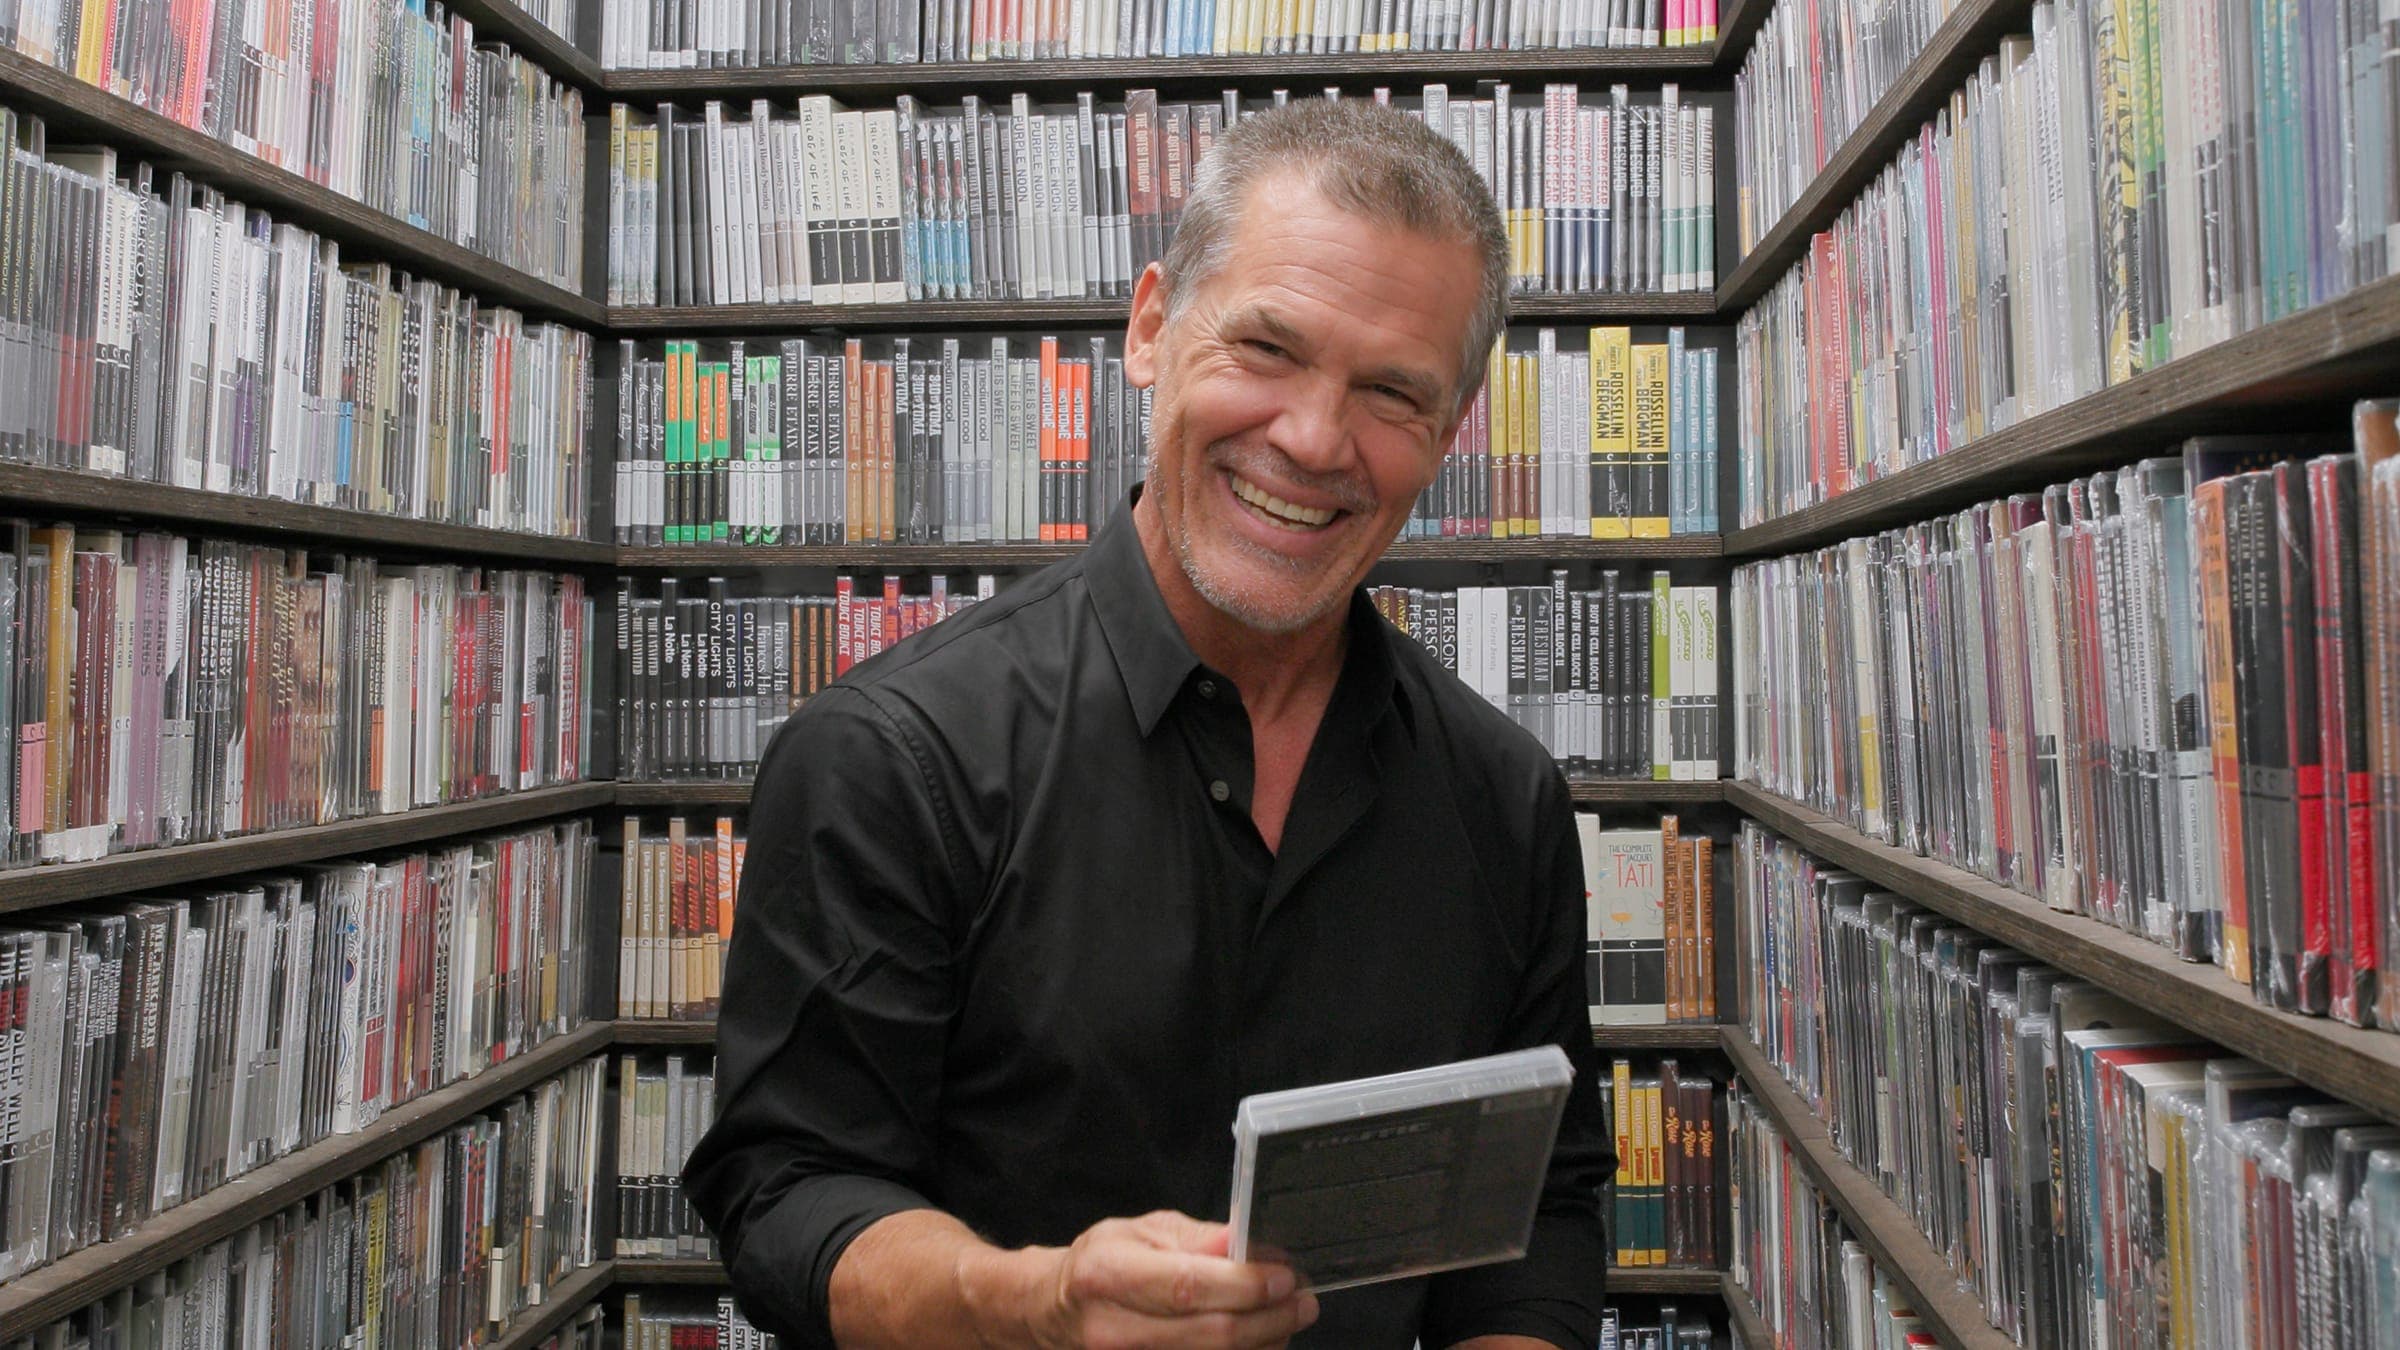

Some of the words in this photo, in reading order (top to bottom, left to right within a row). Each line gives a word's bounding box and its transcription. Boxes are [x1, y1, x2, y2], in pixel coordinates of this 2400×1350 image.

[1136, 112, 1148, 128] THE
[1168, 118, 1179, 134] THE
[1562, 93, 1576, 150] MINISTRY
[1664, 102, 1676, 160] BADLANDS
[1014, 116, 1025, 164] PURPLE
[1032, 122, 1042, 170] PURPLE
[1048, 126, 1058, 174] PURPLE
[1065, 125, 1076, 174] PURPLE
[1136, 131, 1148, 155] QATSI
[1648, 128, 1659, 150] MAN
[1680, 120, 1694, 178] BADLANDS
[1699, 119, 1712, 176] BADLANDS
[810, 164, 818, 179] OF
[842, 170, 850, 182] OF
[874, 170, 882, 183] OF
[1136, 156, 1150, 192] TRILOGY
[1562, 154, 1576, 168] OF
[1598, 166, 1609, 177] OF
[1630, 154, 1642, 197] ESCAPED
[1648, 154, 1659, 198] ESCAPED
[1016, 170, 1028, 203] NOON
[1034, 176, 1045, 209] NOON
[1052, 180, 1062, 212] NOON
[1068, 179, 1079, 212] NOON
[1168, 162, 1181, 198] TRILOGY
[1562, 172, 1576, 204] FEAR
[1598, 180, 1609, 205] FEAR
[812, 184, 821, 212] LIFE
[844, 187, 852, 210] LIFE
[876, 187, 884, 209] LIFE
[945, 350, 955, 396] medium
[994, 349, 1004, 370] LIFE
[786, 352, 796, 402] PIERRE
[808, 359, 819, 409] PIERRE
[978, 368, 990, 414] medium
[994, 375, 1004, 385] IS
[1026, 373, 1036, 394] LIFE
[896, 381, 908, 414] YUMA
[945, 398, 956, 422] cool
[962, 372, 972, 418] medium
[994, 390, 1004, 426] SWEET
[1026, 399, 1036, 408] IS
[1596, 380, 1610, 439] BERGMAN
[1610, 372, 1624, 439] ROSSELLINI
[912, 402, 924, 436] YUMA
[928, 402, 942, 436] YUMA
[979, 417, 990, 441] cool
[1636, 388, 1650, 449] BERGMAN
[1650, 380, 1664, 448] ROSSELLINI
[962, 420, 973, 444] cool
[1026, 414, 1037, 450] SWEET
[2240, 504, 2250, 559] CITIZEN
[2254, 502, 2266, 558] CITIZEN
[618, 591, 628, 606] THE
[840, 590, 850, 620] TOUKI
[1554, 580, 1565, 600] RIOT
[2242, 572, 2253, 609] KANE
[2258, 572, 2268, 608] KANE
[664, 616, 675, 630] La
[711, 602, 720, 631] CITY
[1554, 602, 1565, 612] IN
[1554, 614, 1565, 632] CELL
[1590, 604, 1600, 624] RIOT
[648, 616, 658, 632] THE
[681, 634, 691, 646] La
[698, 634, 707, 646] La
[726, 614, 736, 644] CITY
[744, 612, 754, 642] CITY
[840, 624, 850, 656] BOUKI
[854, 608, 864, 640] TOUKI
[1590, 626, 1600, 636] IN
[664, 633, 675, 664] Notte
[711, 636, 720, 676] LIGHTS
[758, 625, 771, 672] Frances
[774, 622, 788, 669] Frances
[1511, 617, 1526, 679] FRESHMAN
[1534, 620, 1548, 682] FRESHMAN
[1554, 632, 1565, 658] BLOCK
[1590, 638, 1600, 655] CELL
[681, 649, 691, 678] Notte
[698, 649, 707, 678] Notte
[726, 648, 736, 688] LIGHTS
[744, 646, 754, 686] LIGHTS
[1590, 656, 1600, 680] BLOCK
[758, 676, 771, 695] Ha
[774, 672, 788, 692] Ha
[688, 856, 699, 885] RED
[704, 850, 716, 881] RED
[718, 828, 732, 904] JUDEX
[1613, 854, 1654, 888] TATI
[704, 883, 716, 926] RIVER
[11, 1032, 27, 1085] SLEEP
[6, 1092, 22, 1142] WELL
[1666, 1117, 1679, 1144] Rose
[1683, 1130, 1696, 1158] Rose
[1700, 1130, 1712, 1158] Rose
